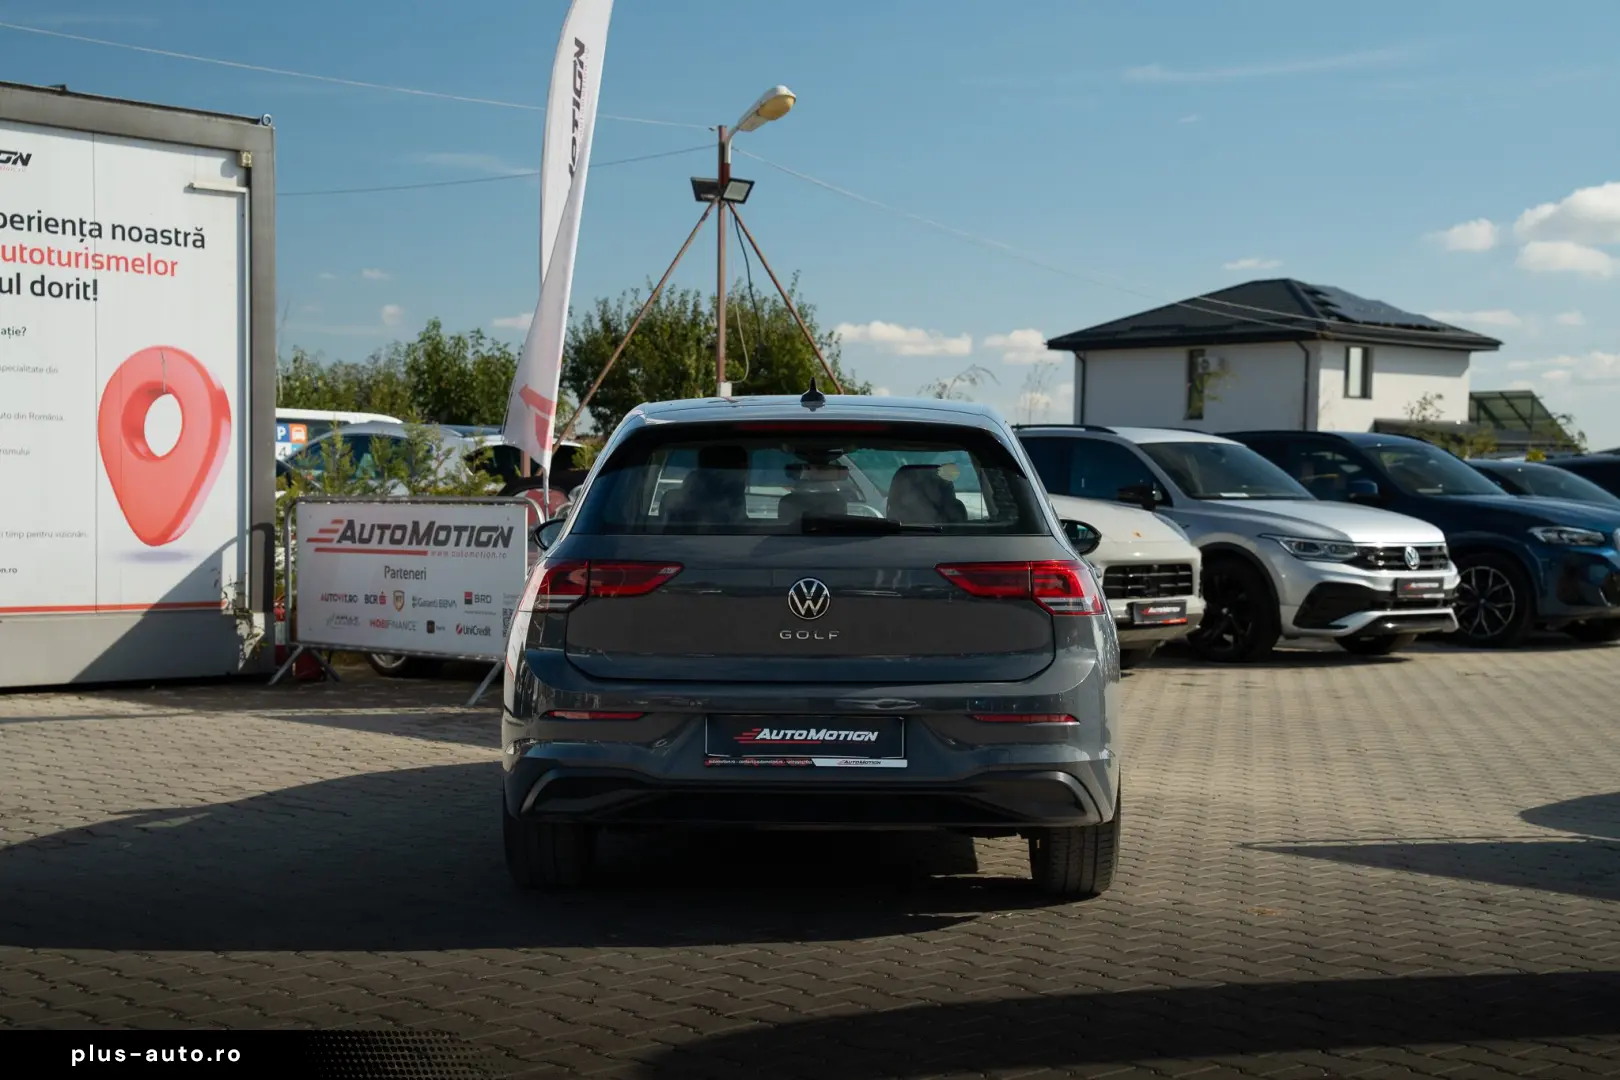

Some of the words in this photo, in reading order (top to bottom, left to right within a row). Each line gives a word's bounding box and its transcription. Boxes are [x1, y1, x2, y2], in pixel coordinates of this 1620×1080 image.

[111, 222, 205, 249] noastră
[1, 243, 179, 277] utoturismelor
[30, 274, 98, 301] dorit!
[0, 364, 44, 375] pecialitate
[45, 366, 59, 374] din
[13, 412, 27, 420] din
[277, 425, 287, 441] P
[384, 565, 427, 580] Parteneri
[364, 593, 379, 604] BCR
[474, 594, 492, 604] BRD
[779, 630, 840, 640] GOLF
